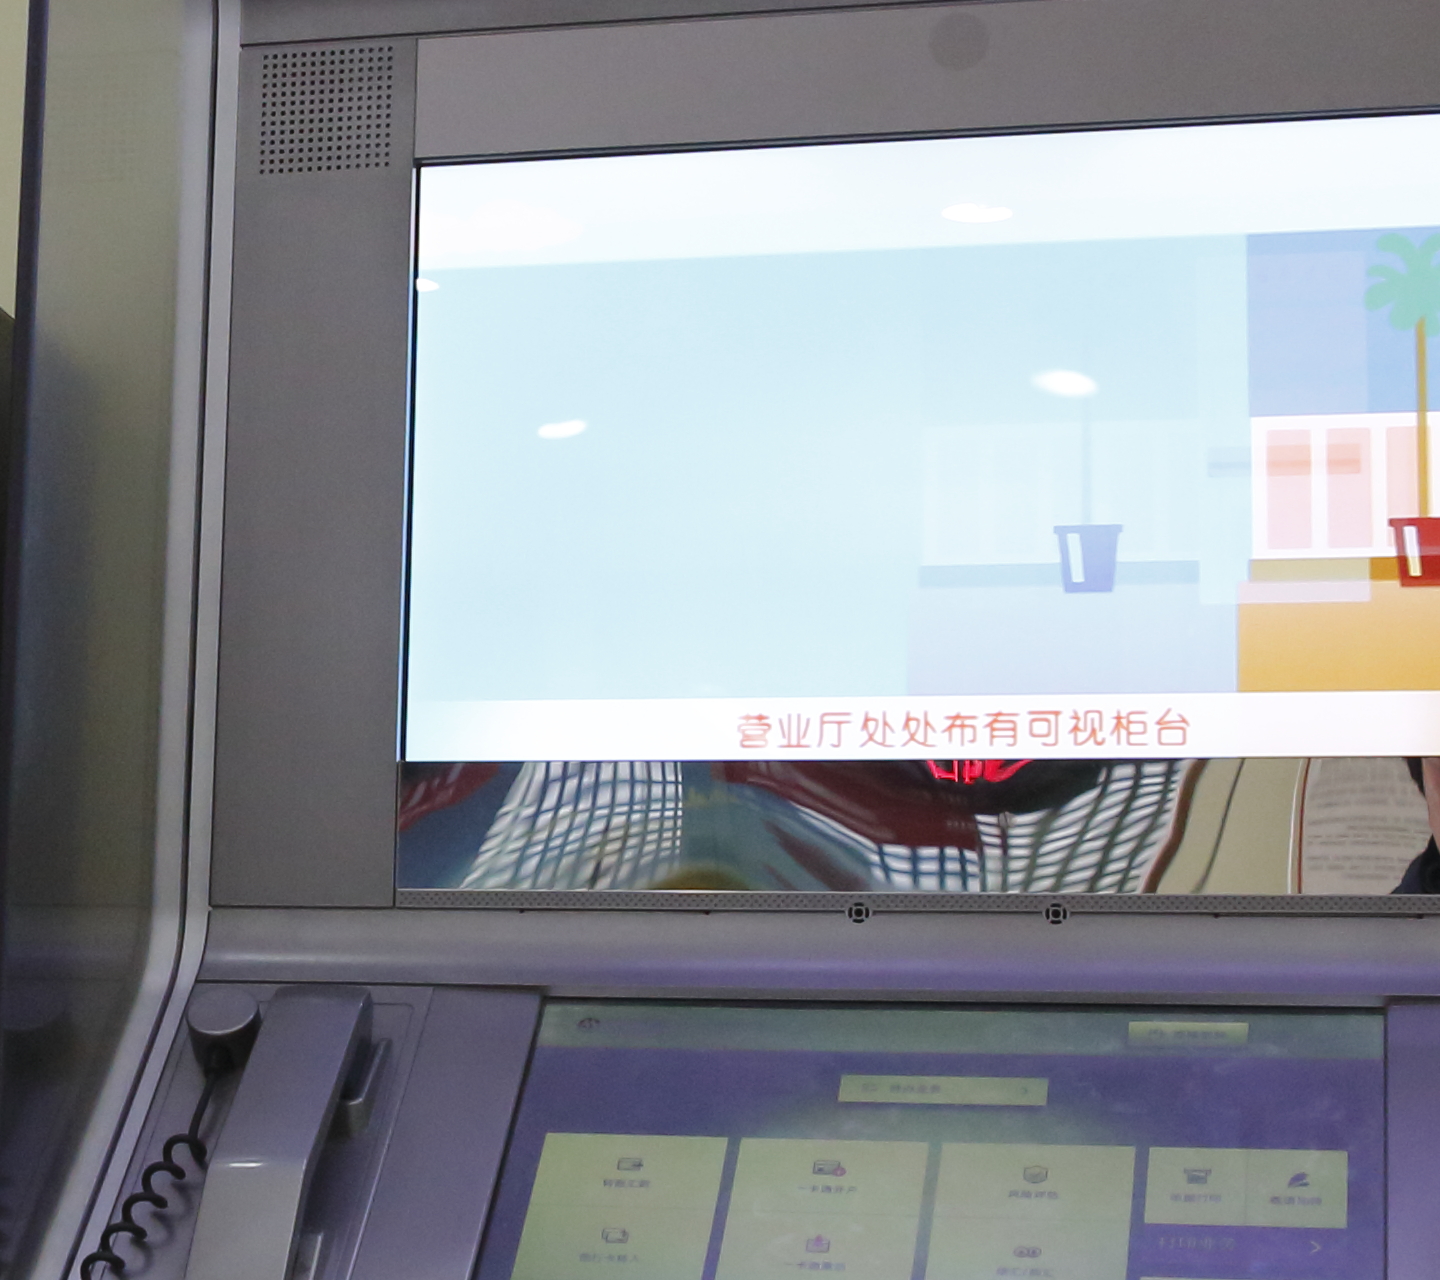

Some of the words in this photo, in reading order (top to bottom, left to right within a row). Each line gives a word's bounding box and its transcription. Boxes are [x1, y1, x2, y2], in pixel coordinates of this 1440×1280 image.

[736, 707, 1191, 749] 营业厅处处布有可视柜台
